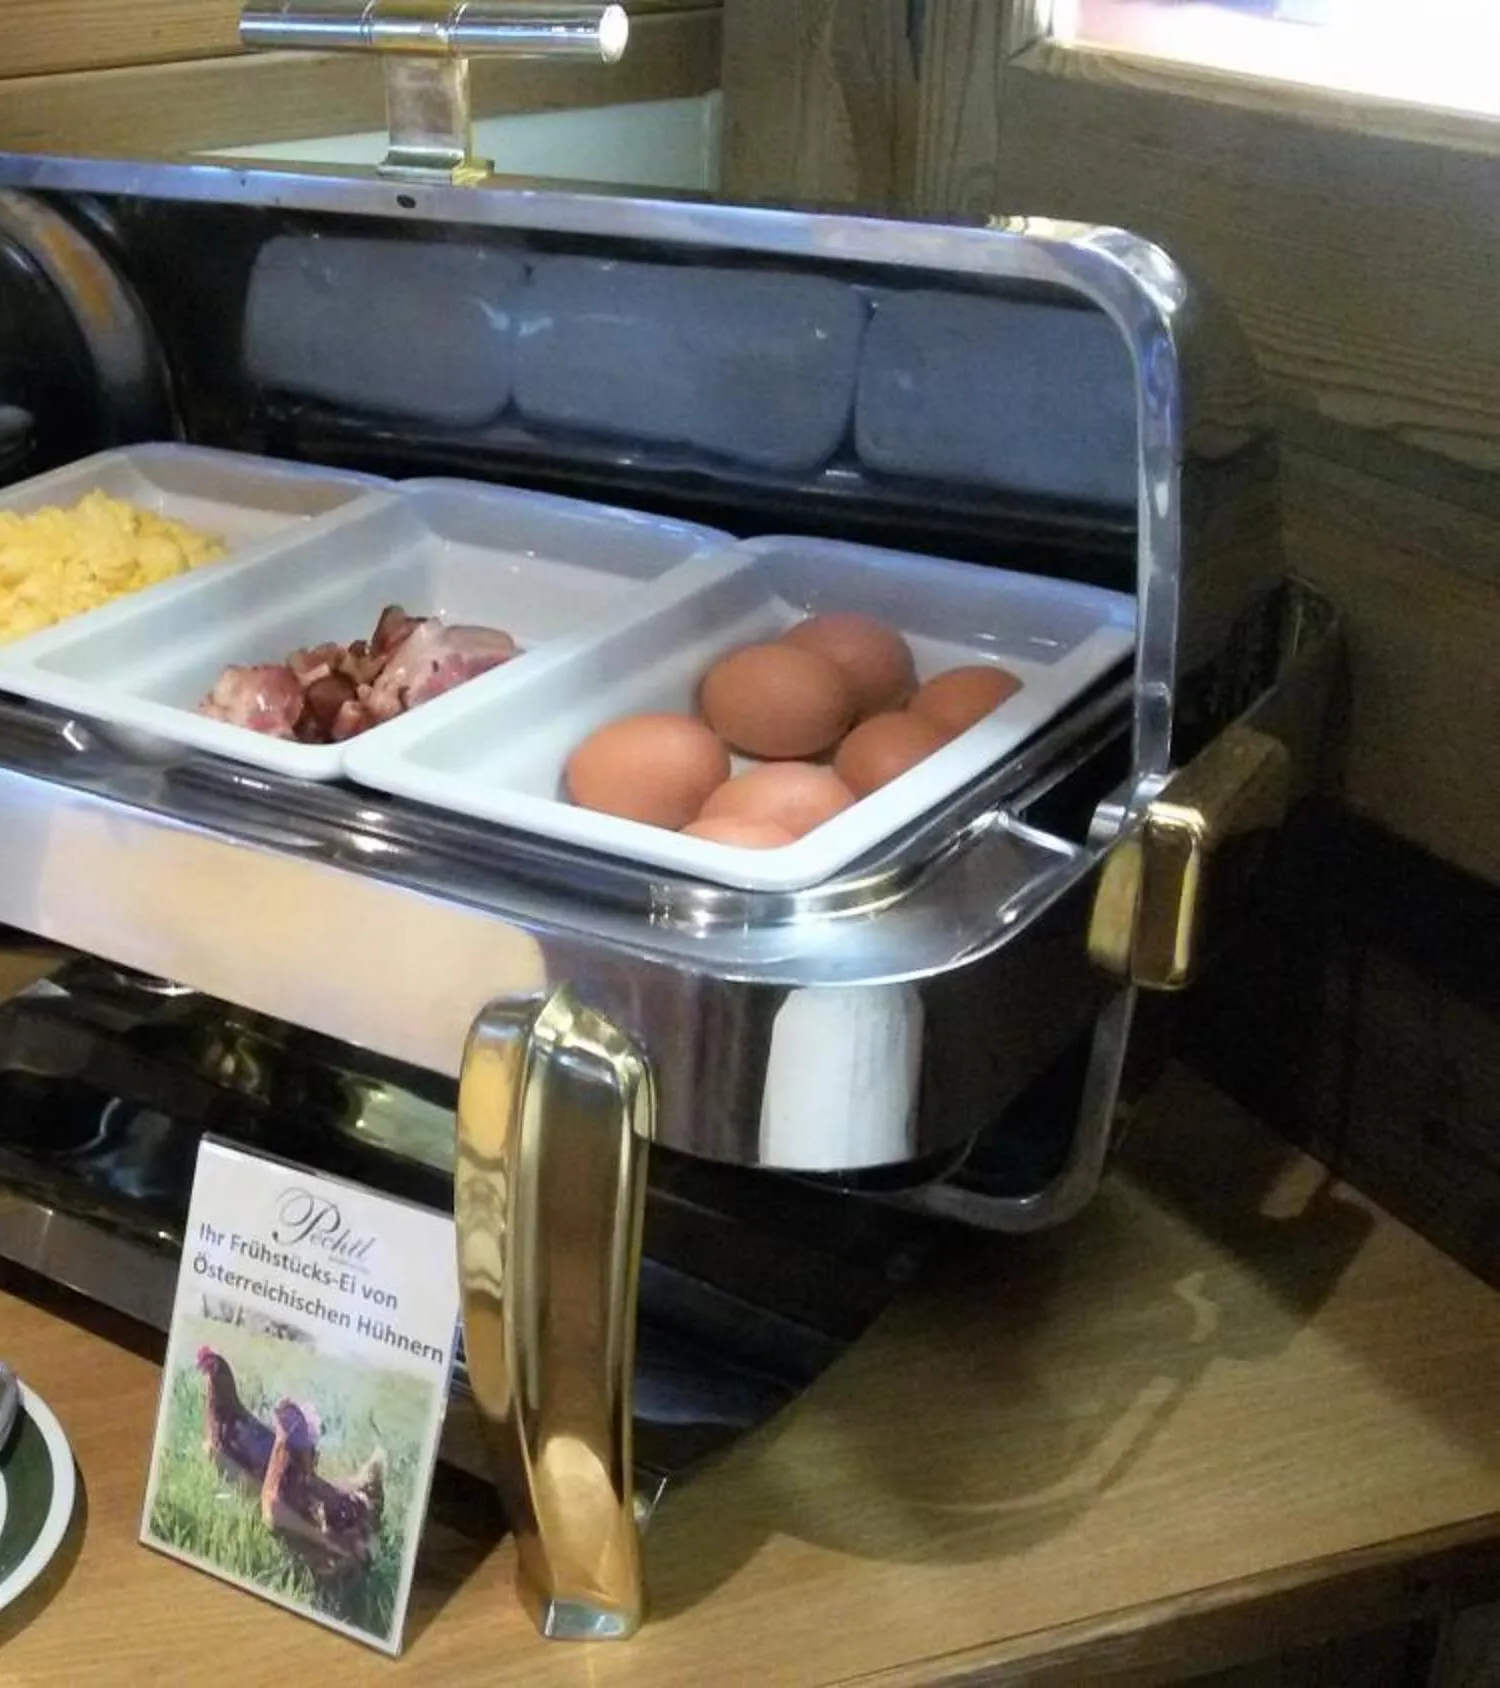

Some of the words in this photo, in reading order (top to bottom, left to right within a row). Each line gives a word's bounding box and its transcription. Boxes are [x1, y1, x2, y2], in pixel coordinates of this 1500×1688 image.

[192, 1252, 352, 1329] Österreichischen
[357, 1316, 445, 1366] Hühnern
[199, 1221, 226, 1247] Ihr
[230, 1233, 357, 1296] Frühstücks-Ei
[362, 1285, 399, 1311] von
